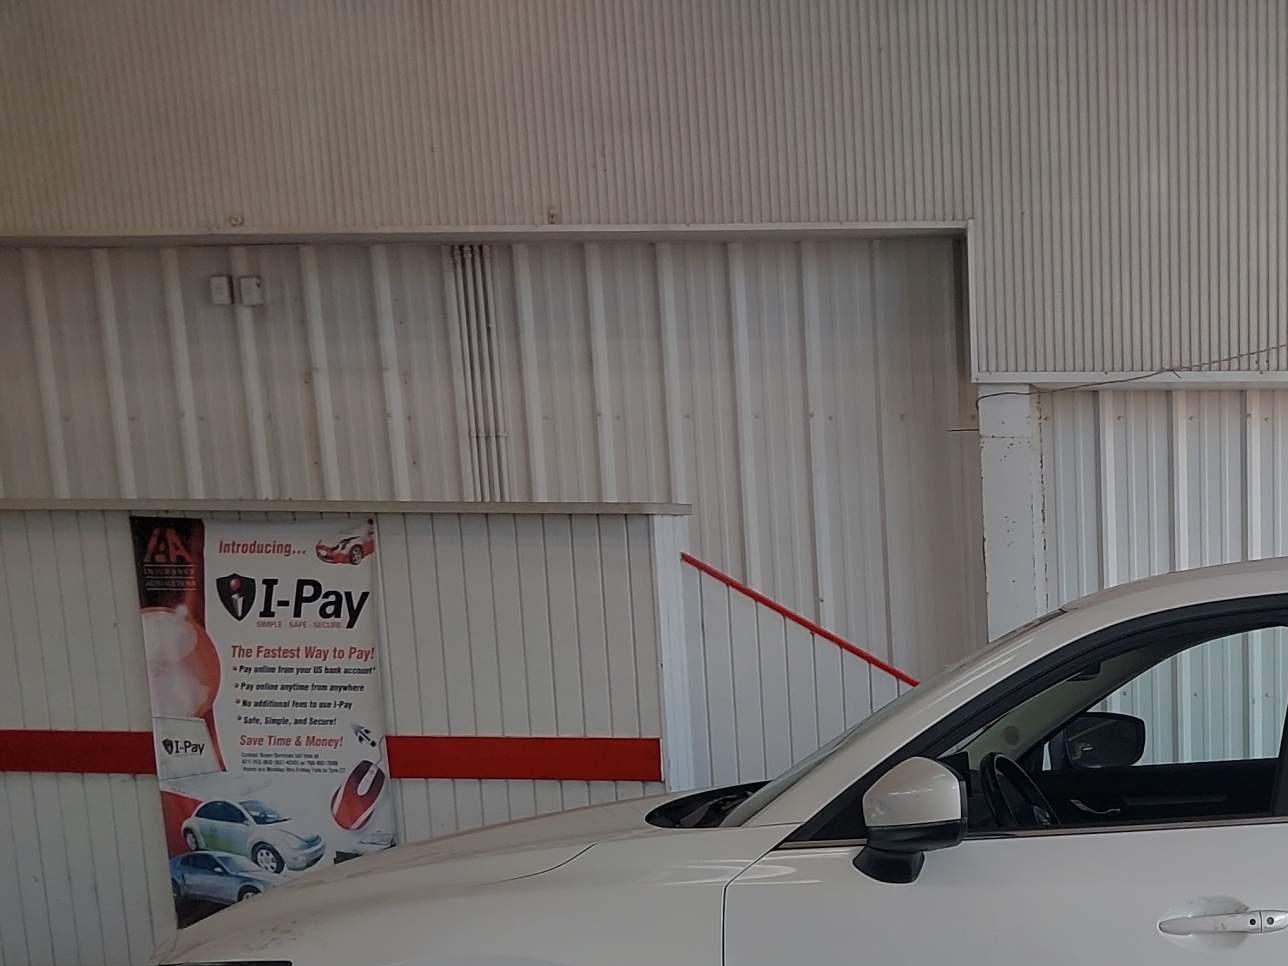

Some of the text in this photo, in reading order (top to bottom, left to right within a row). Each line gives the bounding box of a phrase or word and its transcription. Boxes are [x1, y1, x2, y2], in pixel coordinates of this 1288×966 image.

[218, 540, 306, 557] Introducing...
[259, 578, 370, 629] I-Pay
[231, 645, 375, 662] The Fastest Way to Pay!
[239, 665, 252, 674] Pay
[254, 665, 276, 673] online
[278, 665, 295, 673] from
[296, 667, 312, 675] your
[313, 666, 323, 674] US
[324, 666, 341, 674] bank
[240, 682, 364, 692] Pay online anytime from anywhere
[253, 700, 290, 708] additional
[292, 700, 308, 708] fees
[333, 701, 353, 711] I-Pay
[243, 716, 337, 726] Safe, Simple, and Secure!
[174, 740, 205, 755] I-Pay
[239, 735, 344, 749] Save Time & Money!
